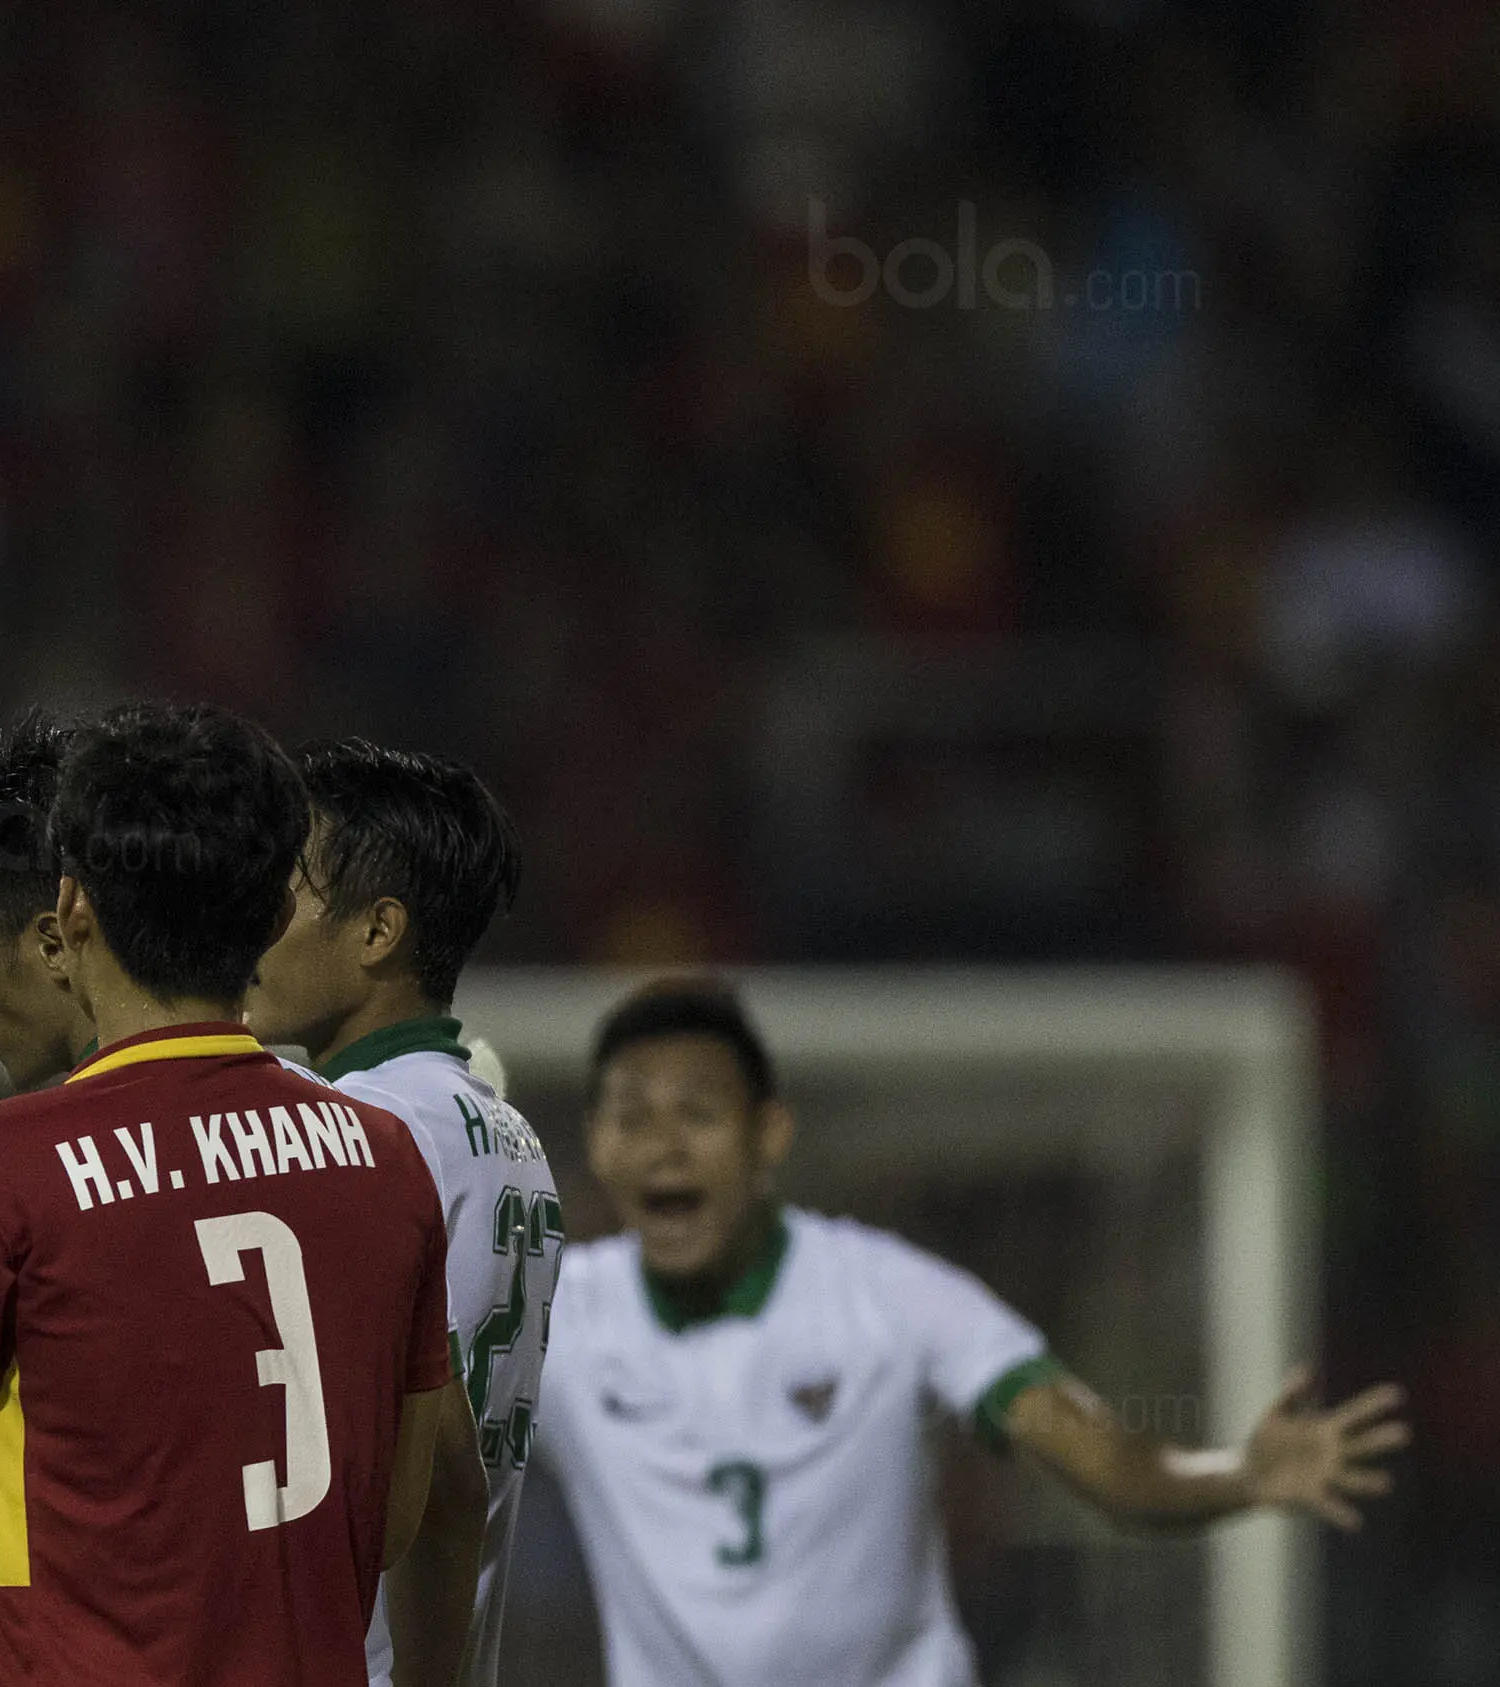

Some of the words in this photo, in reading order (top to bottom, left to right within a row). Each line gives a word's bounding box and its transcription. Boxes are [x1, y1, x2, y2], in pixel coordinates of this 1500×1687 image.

[55, 1122, 185, 1211] H.V.
[189, 1101, 376, 1185] KHANH
[194, 1211, 331, 1531] 3
[704, 1457, 766, 1567] 3
